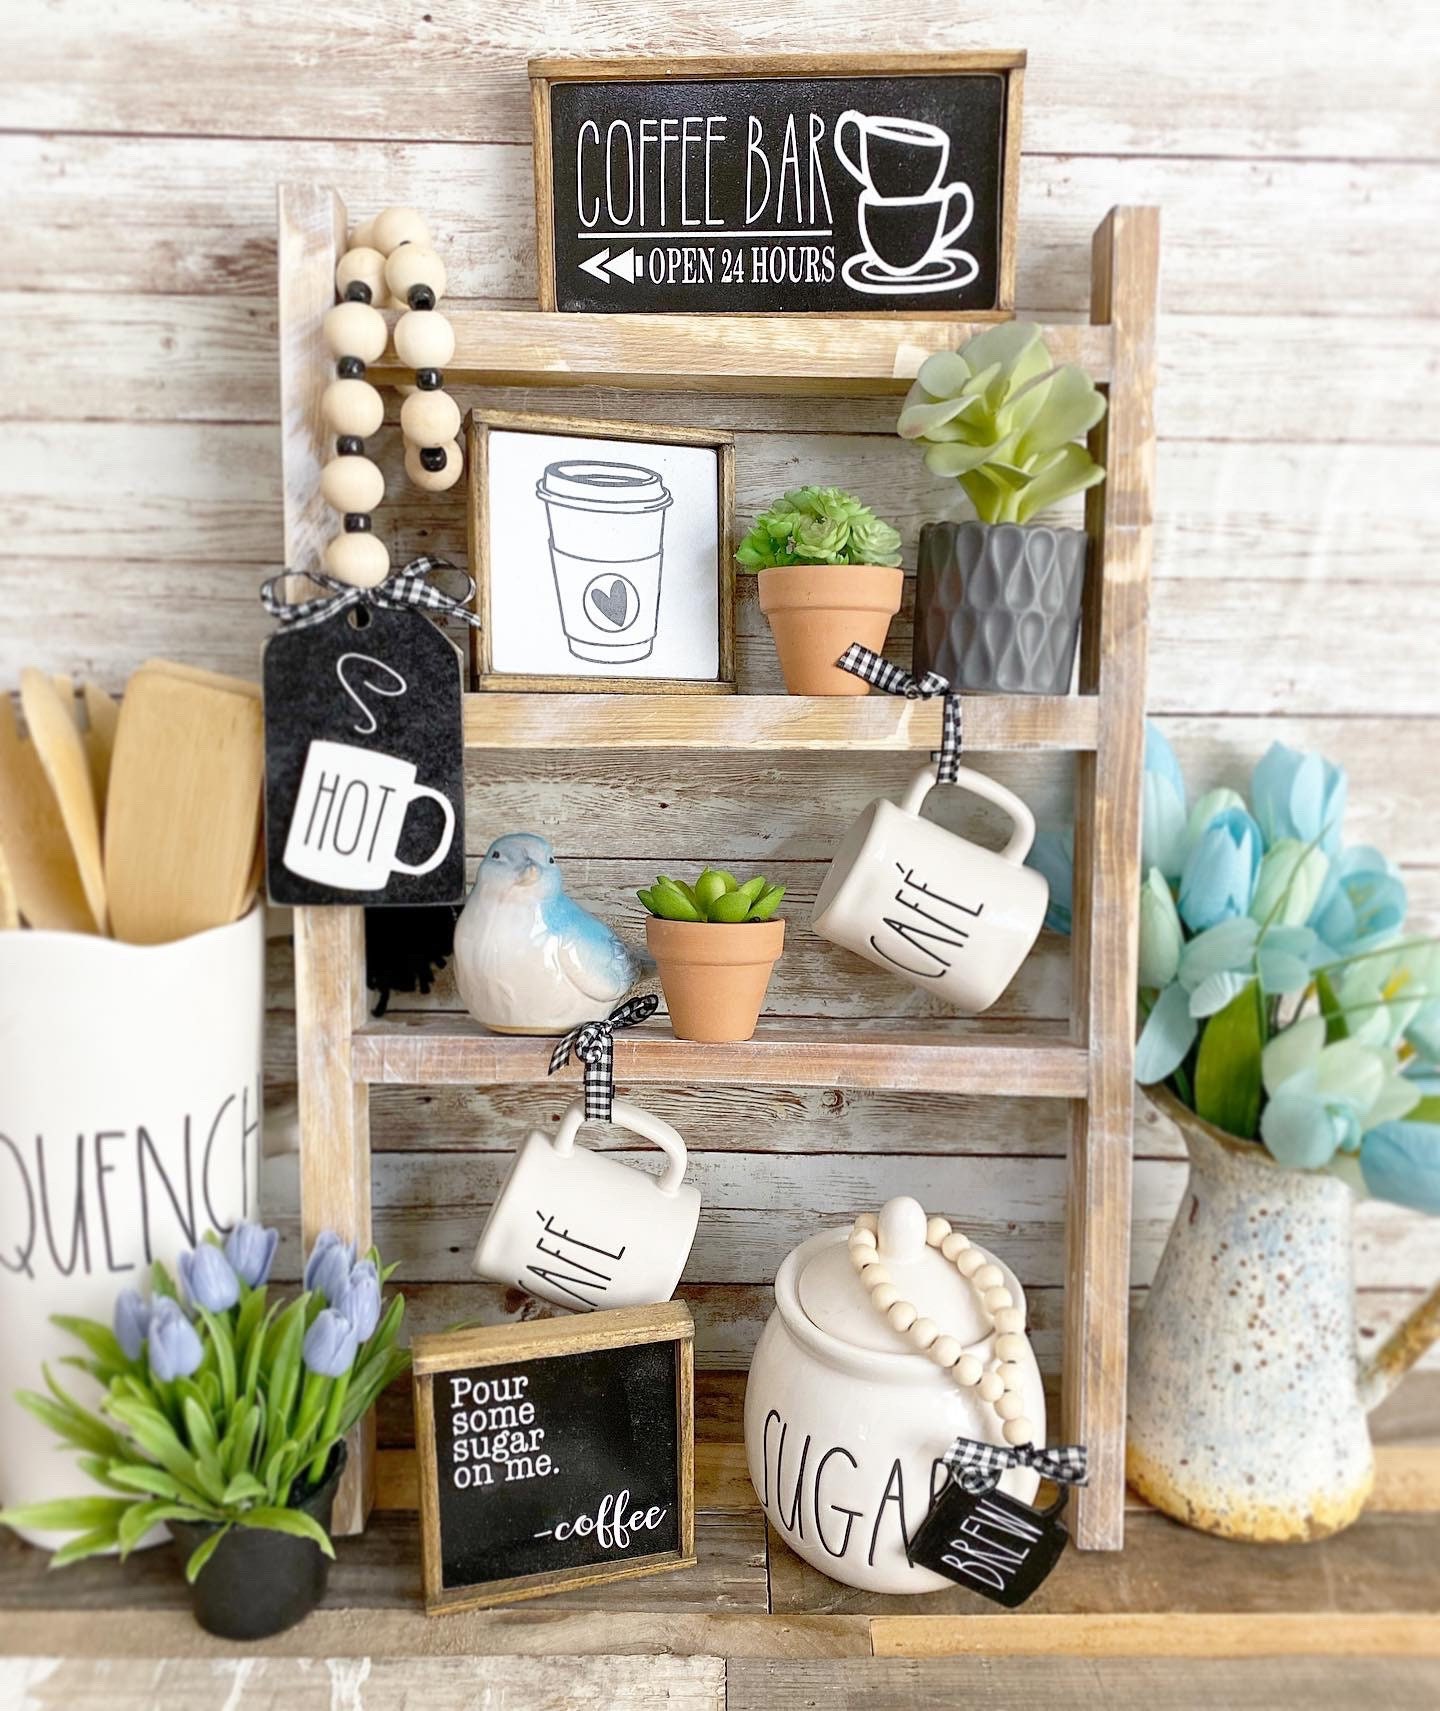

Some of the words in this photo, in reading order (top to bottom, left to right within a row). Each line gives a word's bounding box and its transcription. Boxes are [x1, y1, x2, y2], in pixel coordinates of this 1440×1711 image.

[577, 115, 728, 228] COFFEE
[745, 112, 834, 225] BAR
[648, 248, 714, 284] OPEN
[720, 249, 745, 281] 24
[750, 245, 836, 282] HOURS
[304, 770, 396, 863] HOT
[870, 862, 984, 978] CAFÉ
[450, 1375, 529, 1408] Pour
[452, 1401, 535, 1436] some
[452, 1427, 545, 1463] sugar
[453, 1463, 494, 1490] on
[504, 1453, 560, 1482] me.
[940, 1498, 1044, 1591] BREW
